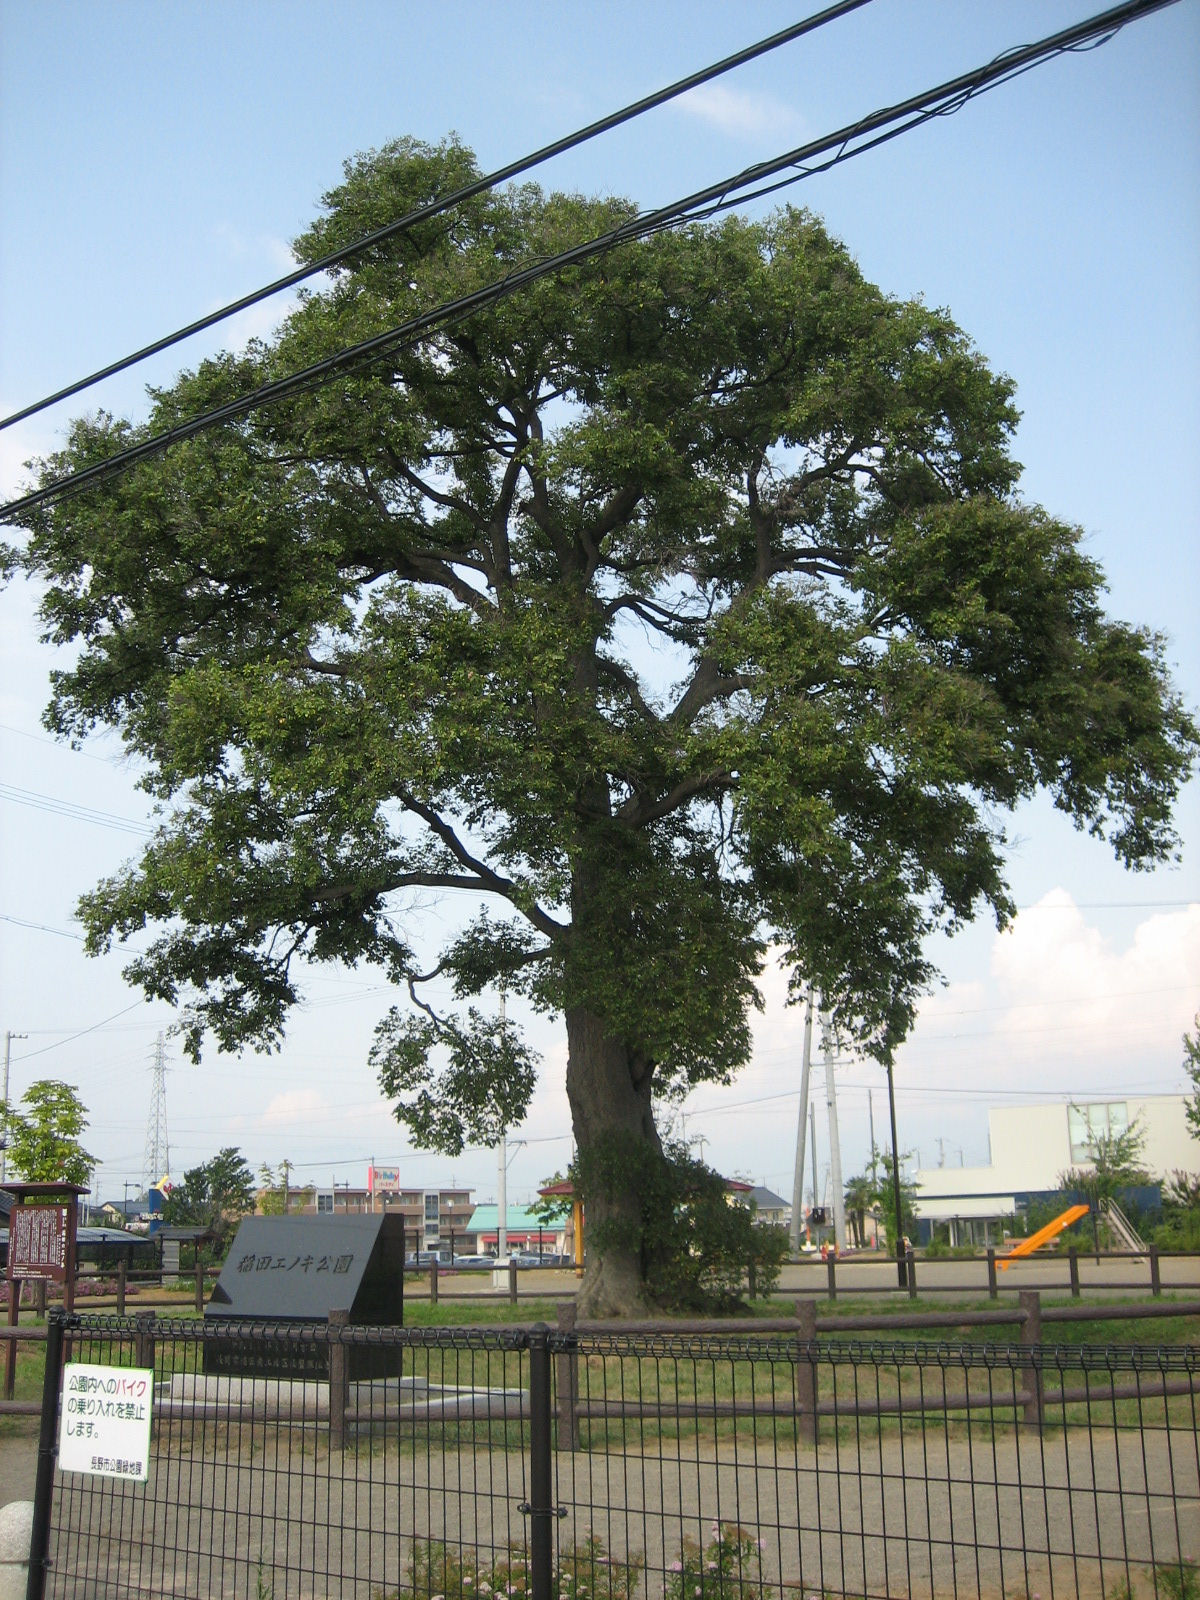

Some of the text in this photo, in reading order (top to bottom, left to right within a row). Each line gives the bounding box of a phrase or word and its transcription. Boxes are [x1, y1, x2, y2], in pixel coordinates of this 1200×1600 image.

[236, 1254, 354, 1274] 稲田エノキ公園
[69, 1375, 146, 1397] 公園内へのバイク
[67, 1397, 146, 1421] の乗り入れを禁止
[66, 1419, 99, 1439] します。
[91, 1456, 143, 1475] 長野市公園緑地課
